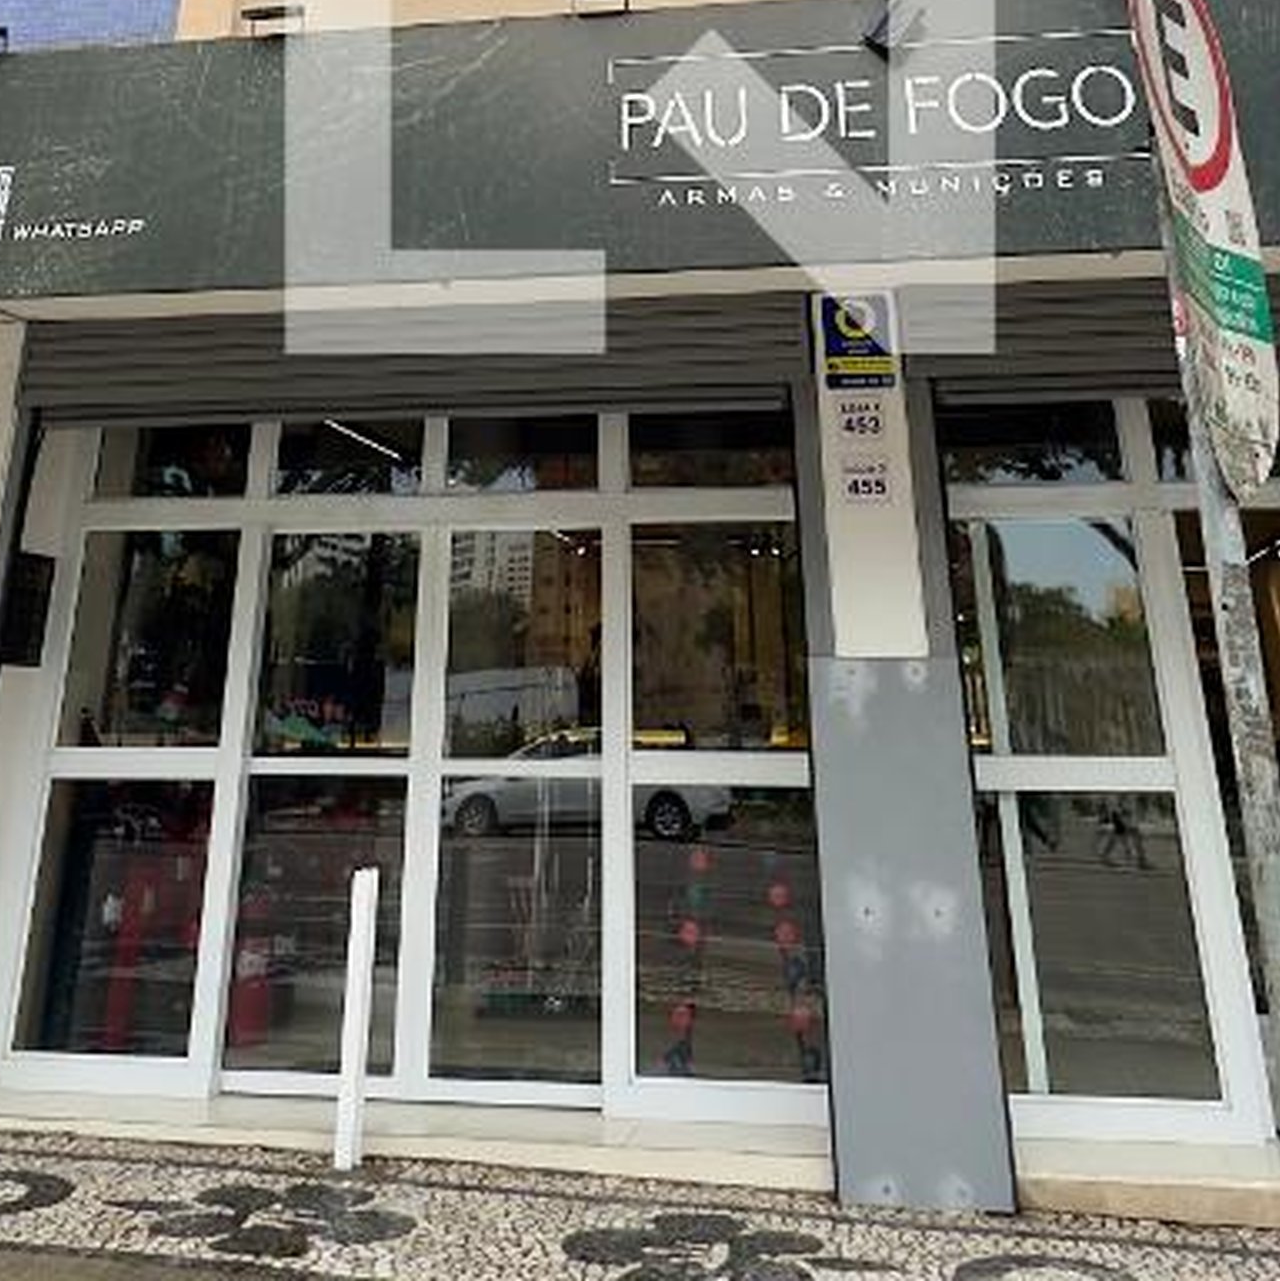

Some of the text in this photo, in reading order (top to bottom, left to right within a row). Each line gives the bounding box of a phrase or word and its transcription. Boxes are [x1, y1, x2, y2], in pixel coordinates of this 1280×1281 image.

[620, 65, 1137, 151] PAU DE FOGO
[658, 184, 795, 206] ARMAS
[13, 219, 144, 240] WHATSAPP
[847, 479, 886, 494] 455
